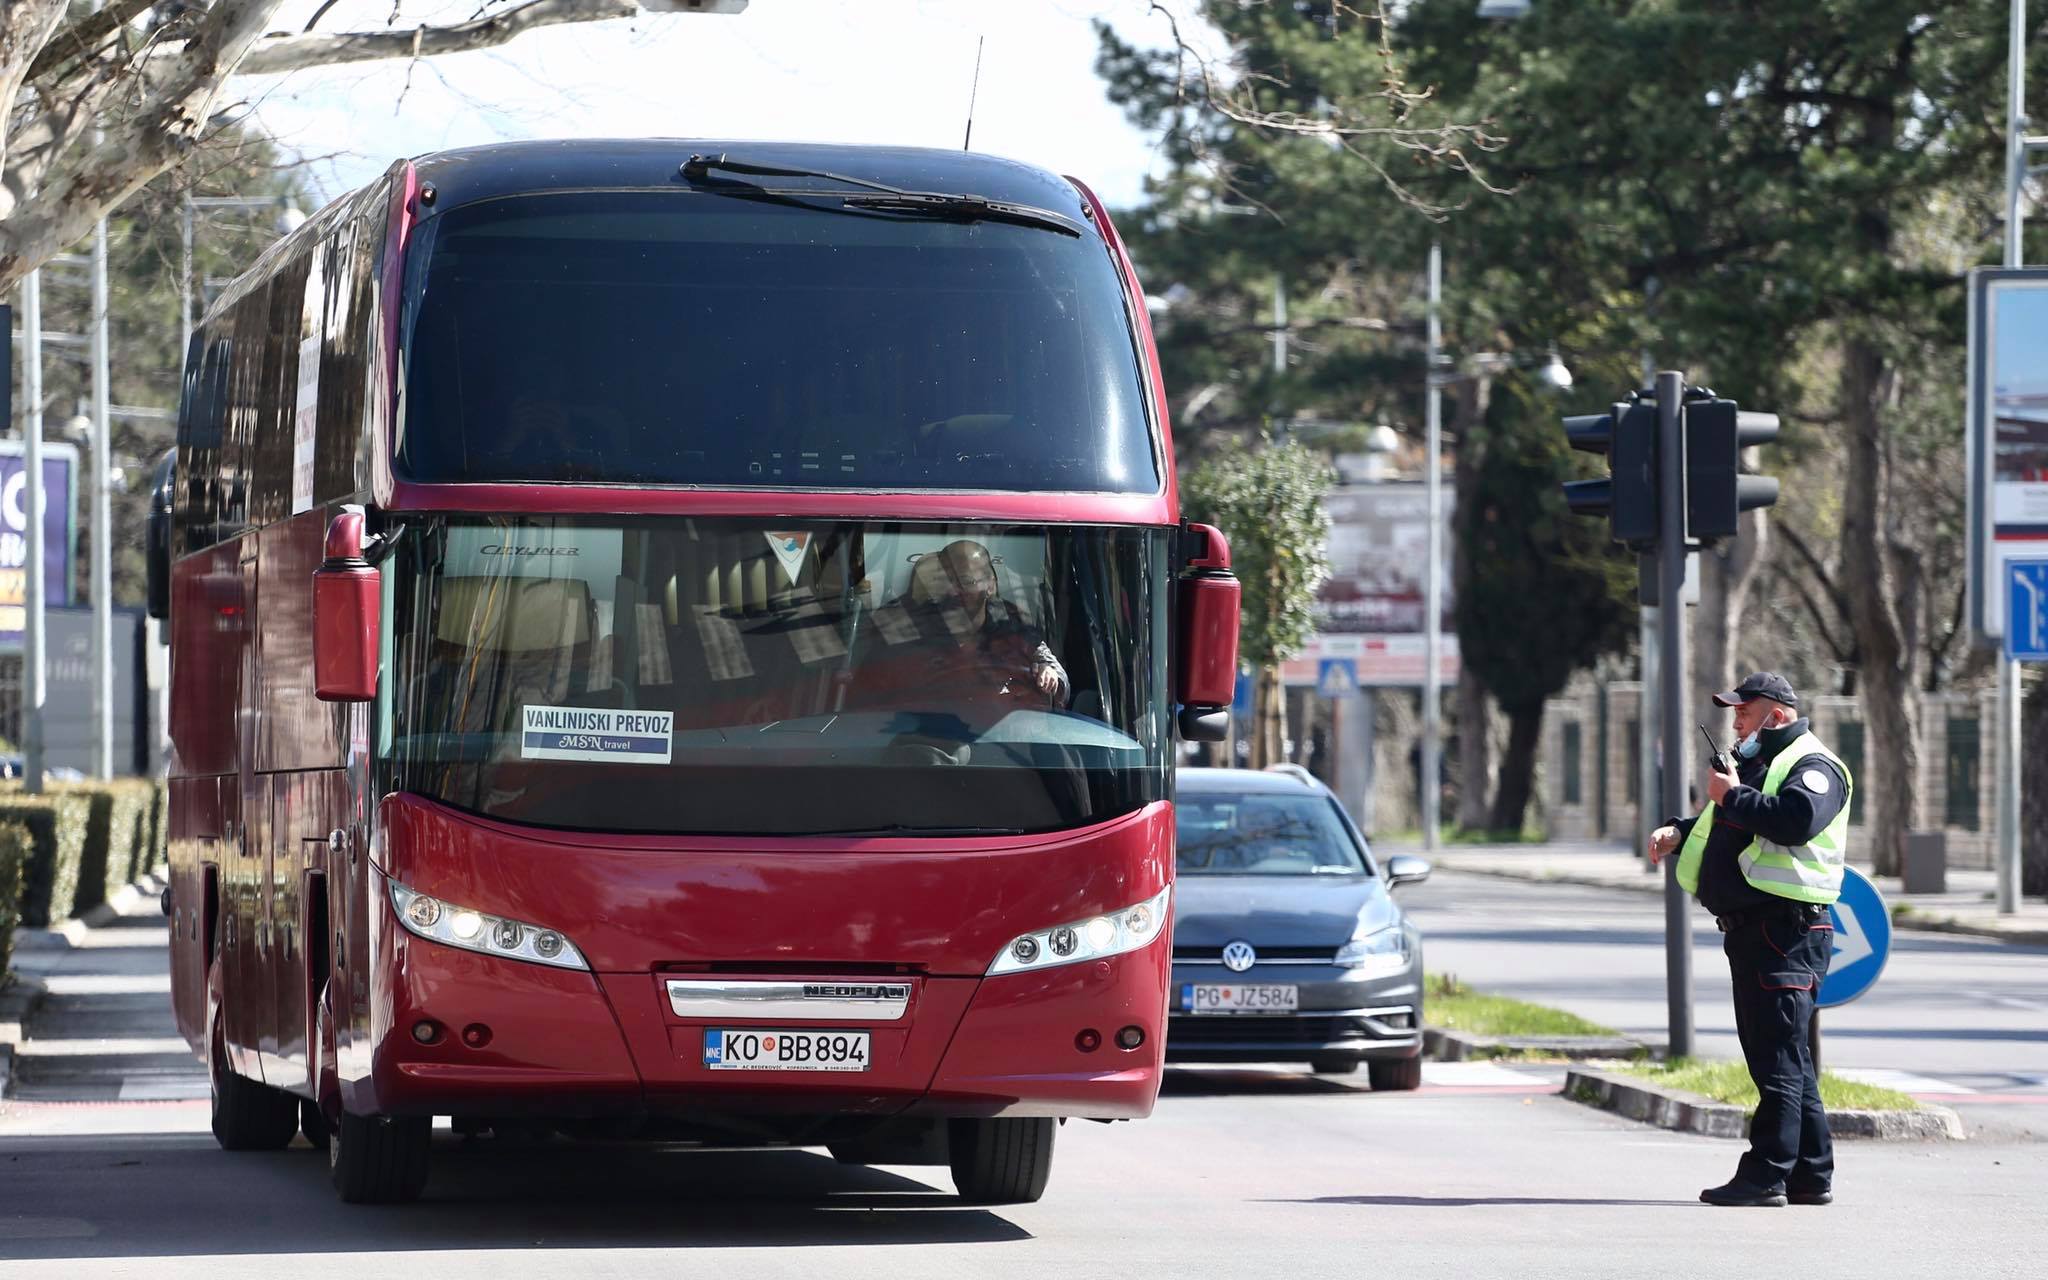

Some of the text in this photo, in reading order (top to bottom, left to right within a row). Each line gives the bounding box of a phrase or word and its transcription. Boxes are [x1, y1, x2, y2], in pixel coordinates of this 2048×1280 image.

[526, 710, 670, 734] VANLINIJSKI PREVOZ
[558, 735, 631, 751] MSN travel
[803, 985, 905, 999] NEOPLAN
[1196, 987, 1294, 1006] PG JZ584
[705, 1047, 721, 1059] MNE
[725, 1034, 865, 1063] KO BB894
